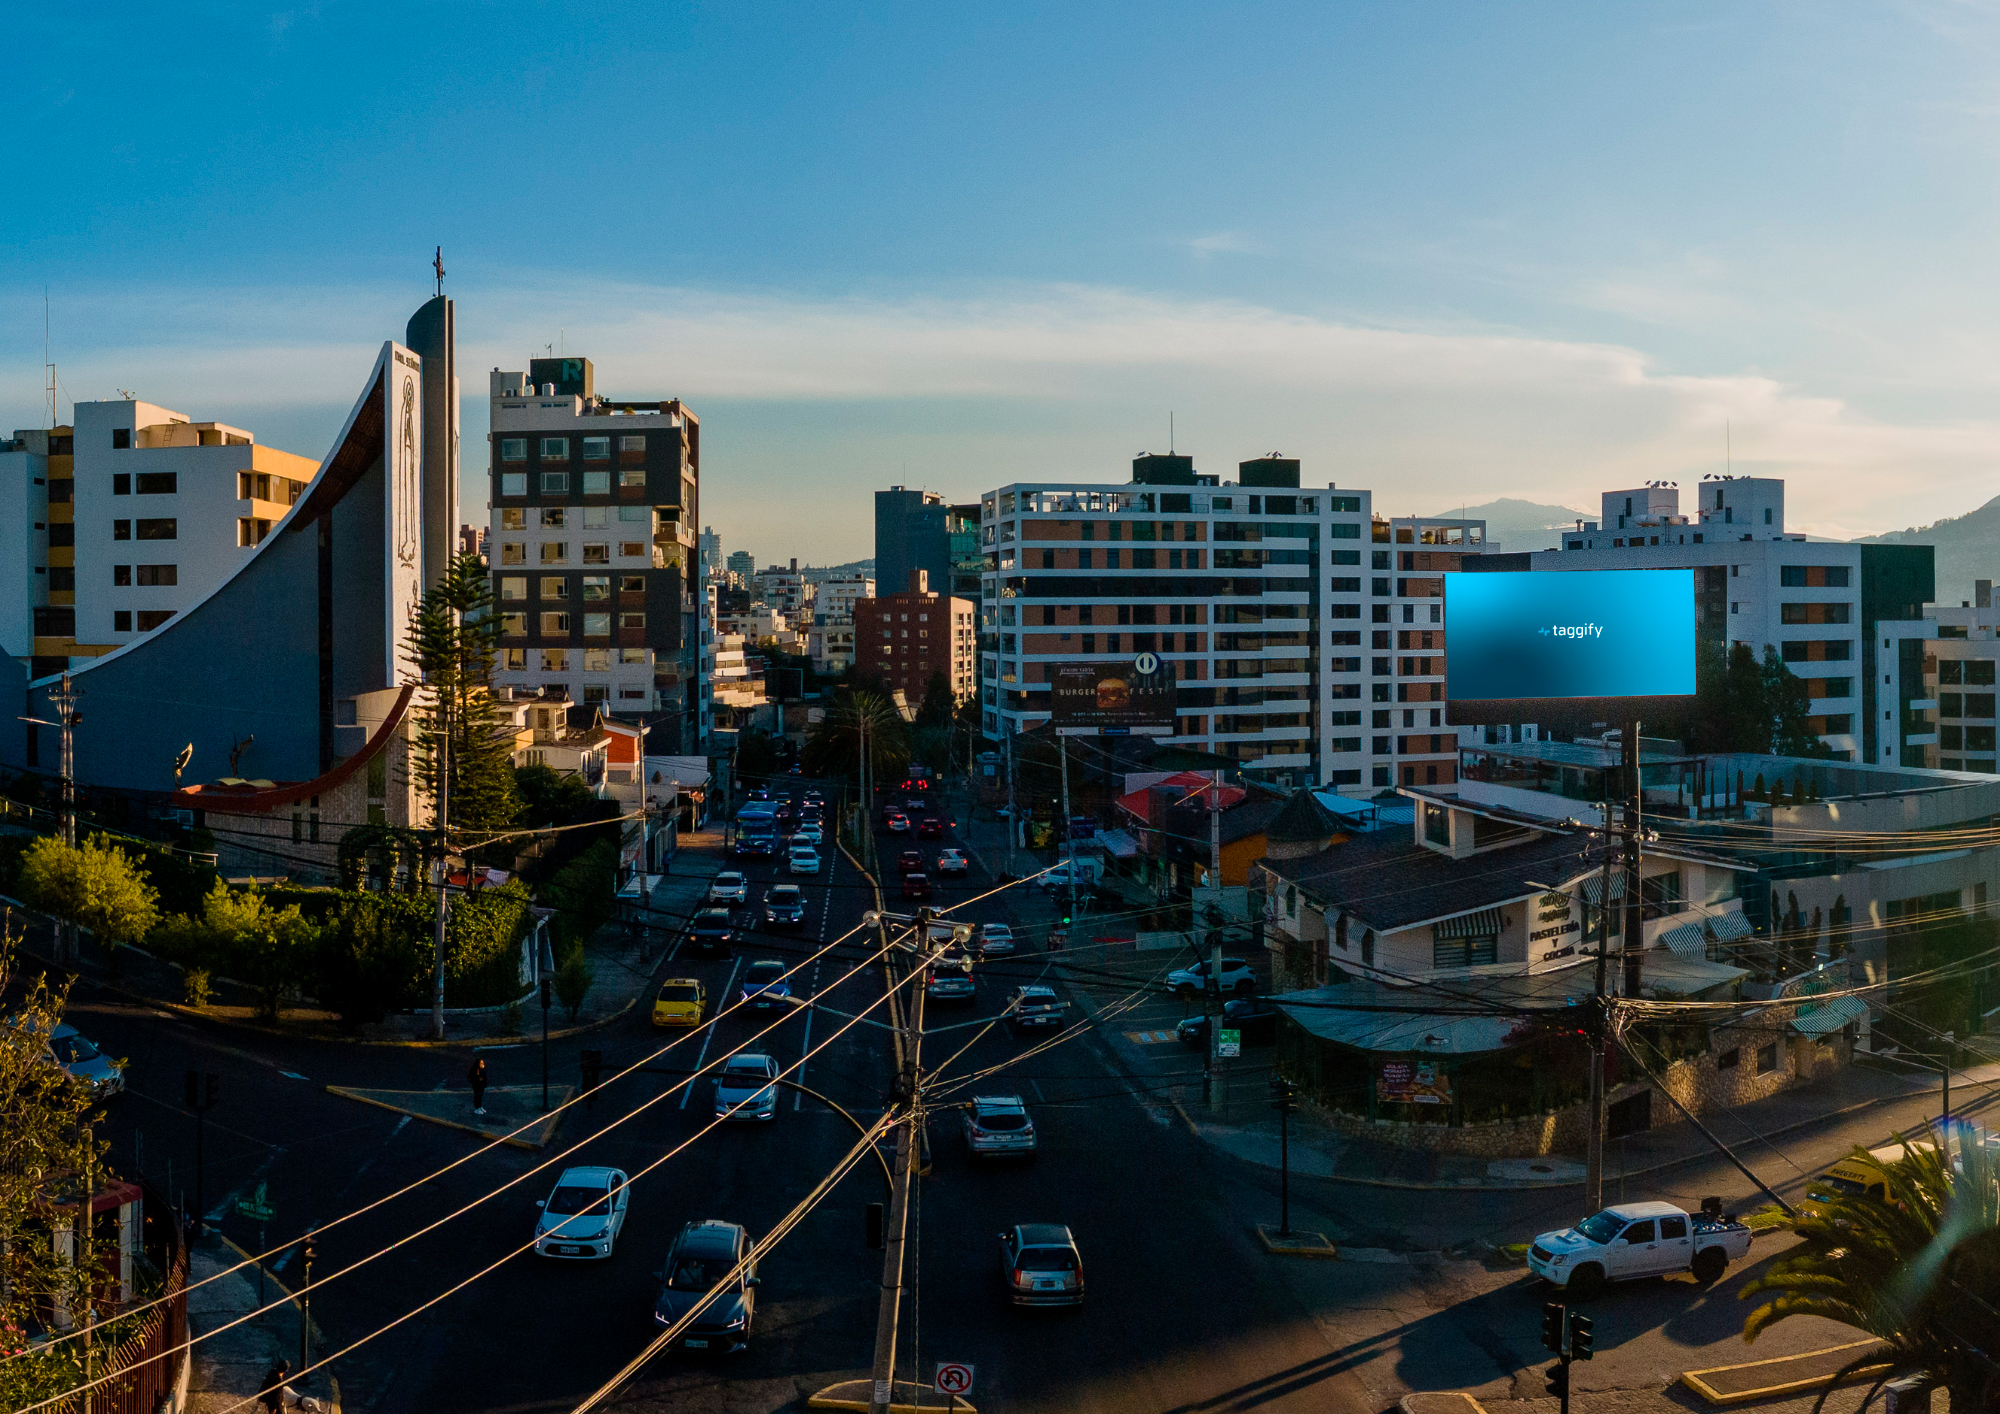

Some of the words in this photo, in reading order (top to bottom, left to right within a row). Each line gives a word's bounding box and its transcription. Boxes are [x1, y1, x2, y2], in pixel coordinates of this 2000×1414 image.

[1552, 623, 1603, 638] taggify
[1059, 688, 1096, 696] BURGER
[1129, 687, 1163, 695] FEST
[1530, 920, 1580, 941] PASTELERÍA
[1552, 938, 1559, 947] Y
[1543, 946, 1575, 961] COCINA
